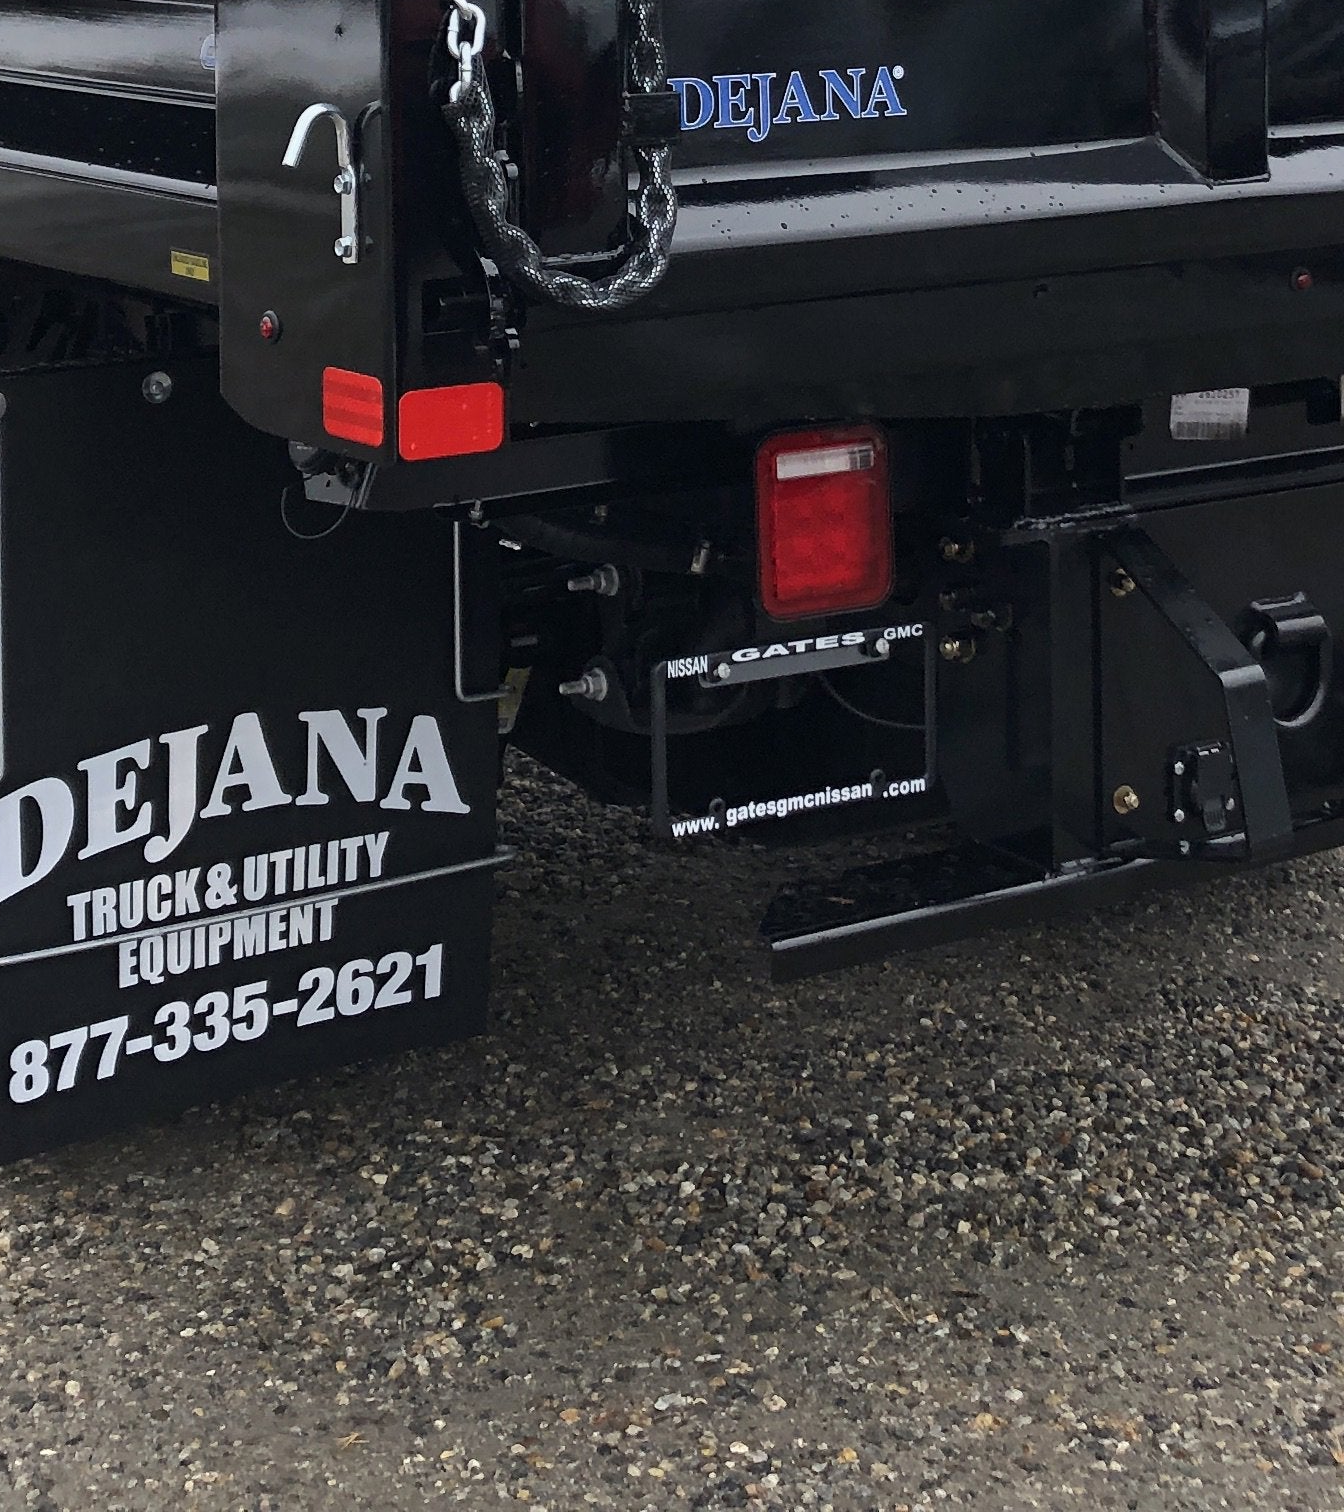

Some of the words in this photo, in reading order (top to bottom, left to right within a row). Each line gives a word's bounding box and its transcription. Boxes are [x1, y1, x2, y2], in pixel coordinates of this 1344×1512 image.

[667, 655, 708, 678] NISSAN
[731, 631, 866, 663] GATES
[883, 623, 924, 640] GMC
[67, 865, 201, 941] TRUCK
[204, 862, 238, 909] &
[242, 830, 390, 902] UTILITY
[118, 897, 338, 989] EQUIPMENT
[8, 942, 444, 1104] 877-335-2621
